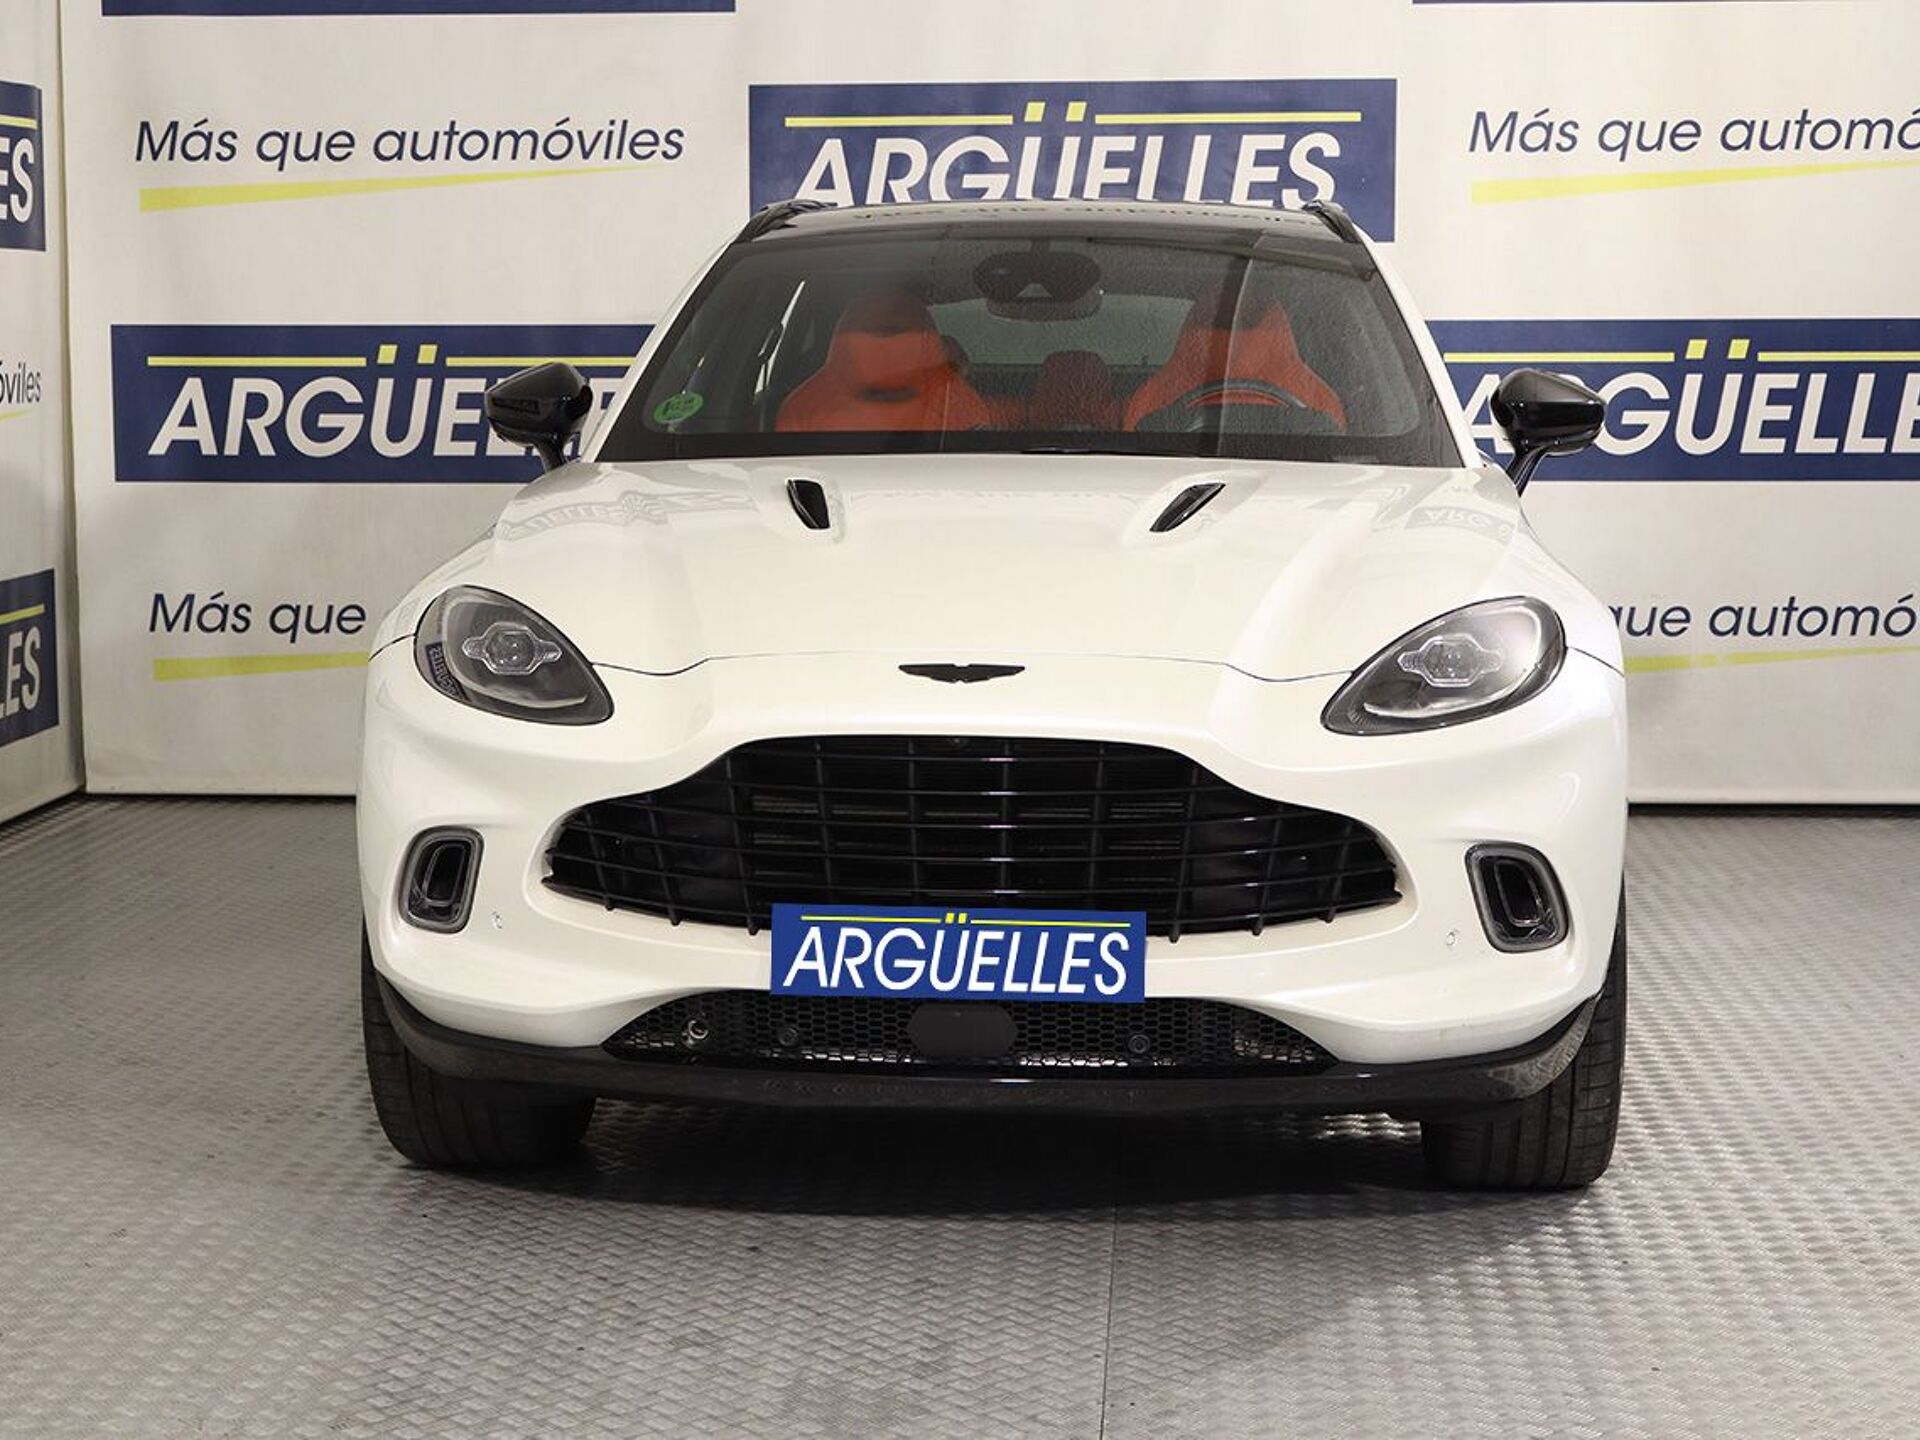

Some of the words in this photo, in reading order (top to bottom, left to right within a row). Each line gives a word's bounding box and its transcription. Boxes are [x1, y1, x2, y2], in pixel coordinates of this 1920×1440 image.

[135, 118, 237, 162] Más
[256, 127, 355, 171] que
[372, 117, 685, 163] automóviles
[792, 101, 1342, 211] ARGÜELLES
[1468, 108, 1579, 153] Más
[1600, 118, 1701, 162] que
[1719, 107, 1920, 152] automó
[1463, 339, 1920, 457] AGÜELLE
[148, 590, 252, 635] Más
[268, 602, 367, 644] que
[1608, 604, 1691, 637] ue
[1709, 593, 1918, 637] automó
